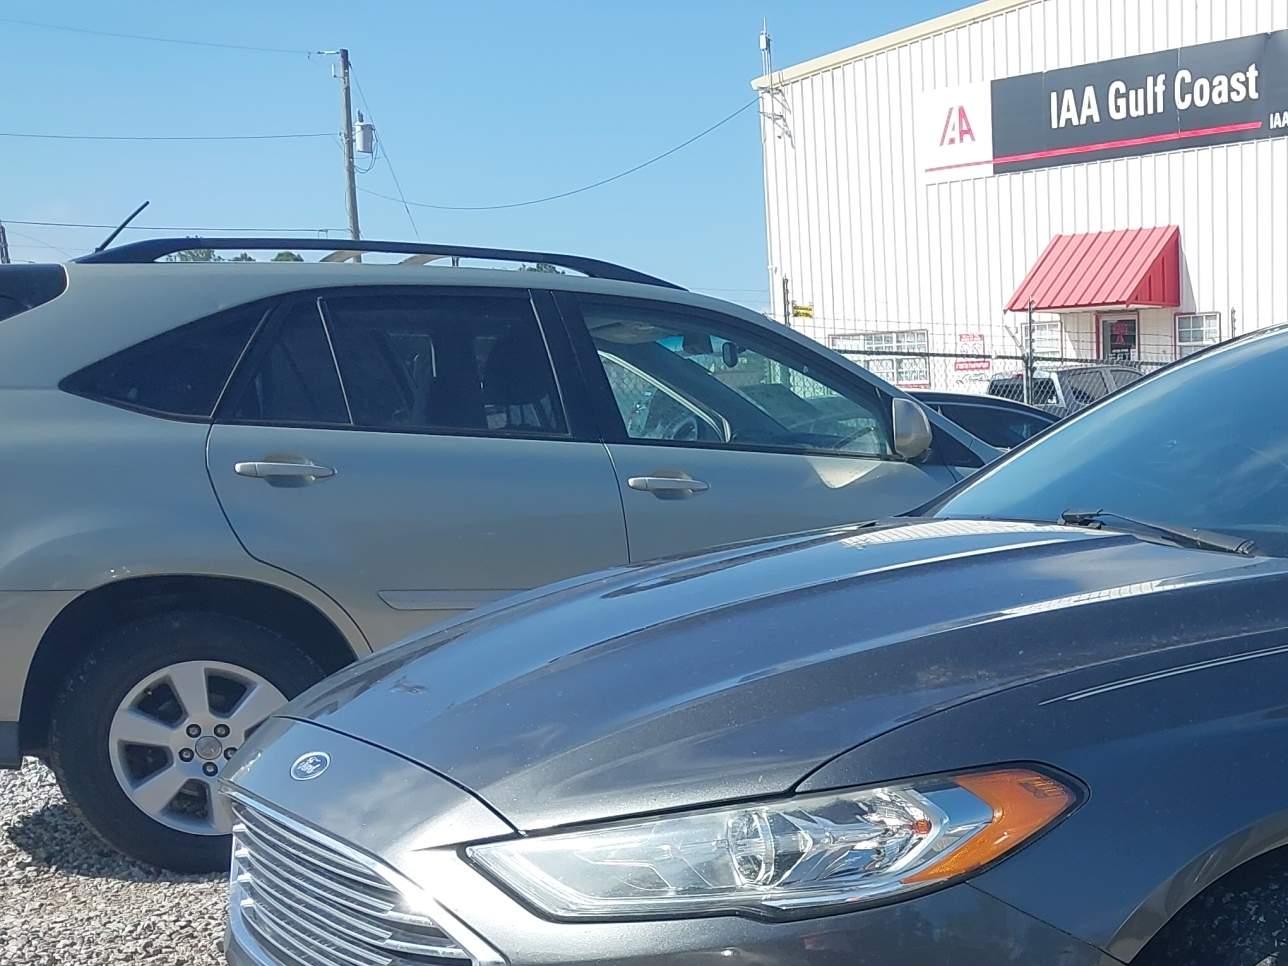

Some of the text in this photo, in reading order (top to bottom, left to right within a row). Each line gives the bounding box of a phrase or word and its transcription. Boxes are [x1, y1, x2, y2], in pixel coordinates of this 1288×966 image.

[1050, 63, 1259, 129] IAA Gulf Coast
